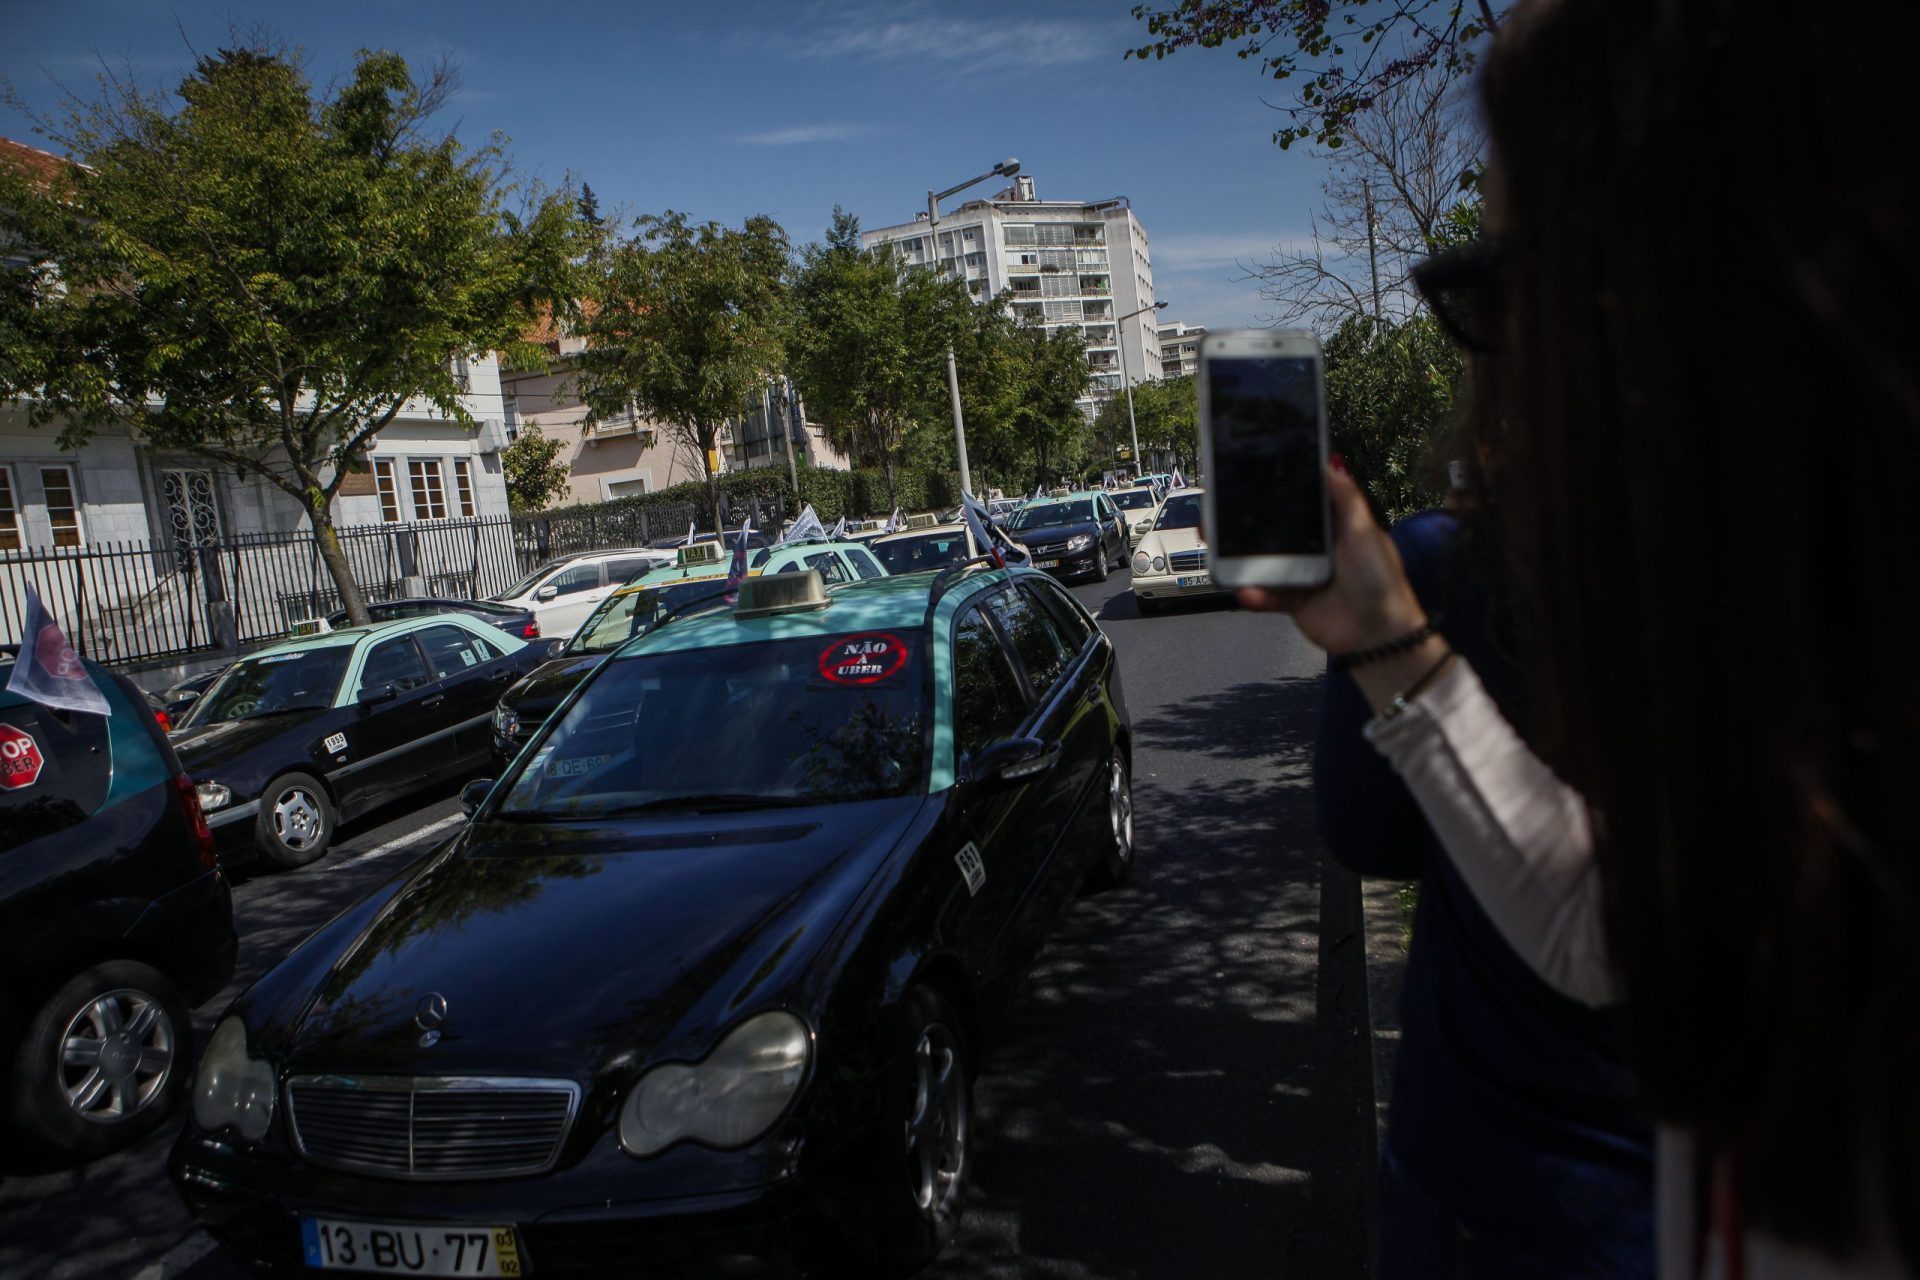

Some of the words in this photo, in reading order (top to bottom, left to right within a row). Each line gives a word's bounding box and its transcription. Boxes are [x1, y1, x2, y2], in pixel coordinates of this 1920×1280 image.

[844, 641, 888, 655] NÃO
[837, 664, 883, 675] UBER
[0, 737, 32, 759] OP
[0, 757, 37, 776] BER
[496, 1230, 514, 1247] 03
